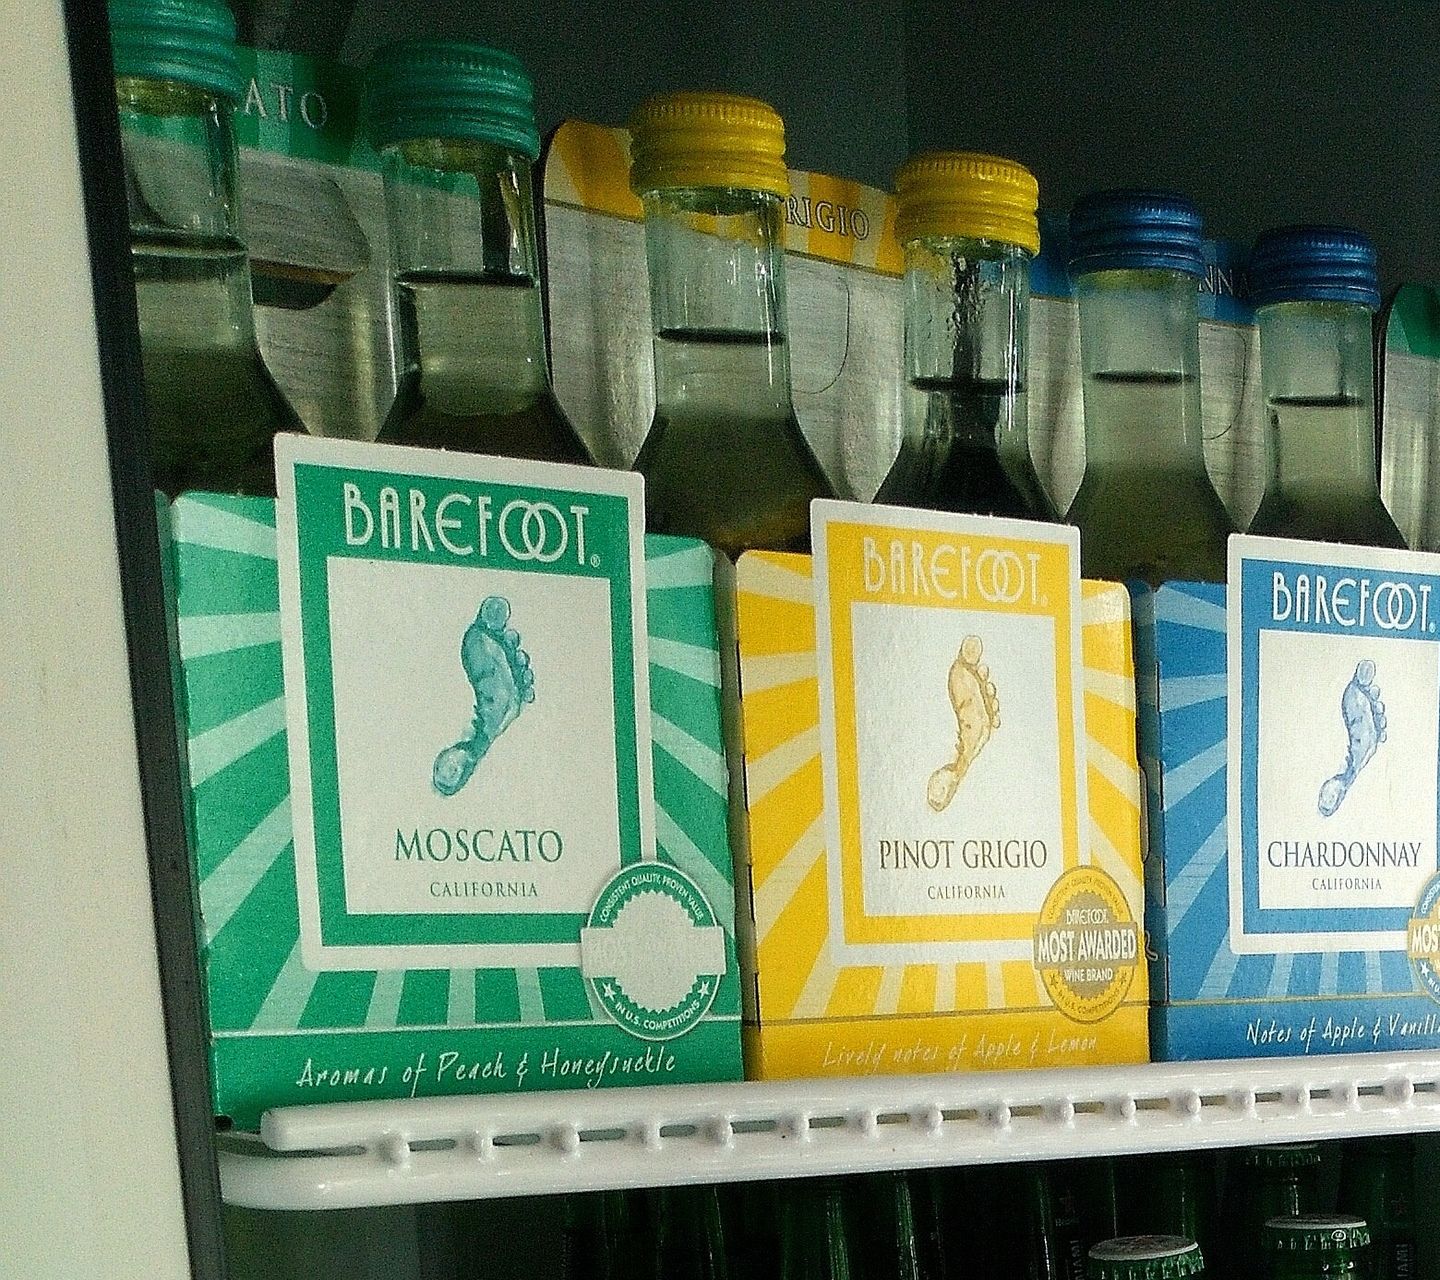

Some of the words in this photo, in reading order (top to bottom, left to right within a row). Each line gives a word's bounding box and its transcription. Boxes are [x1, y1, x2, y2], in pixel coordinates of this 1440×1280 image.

[342, 482, 590, 564] BAREFOOT
[864, 537, 1042, 603] BAREFOOT
[1272, 571, 1431, 632] BAREFOOT
[393, 828, 565, 865] MOSCATO
[878, 840, 955, 869] PINOT
[962, 839, 1049, 869] GRIGIO
[1267, 841, 1421, 869] CHARDONNAY
[429, 880, 539, 899] CALIFORNIA
[927, 884, 1006, 901] CALIFORNIA
[1312, 877, 1382, 891] CALIFORNIA
[1038, 930, 1075, 963] MOST
[1078, 929, 1137, 962] AWARDED
[1064, 968, 1085, 982] WINE
[1087, 967, 1113, 982] BRAND
[643, 999, 701, 1031] COMPETITIONS
[951, 1033, 968, 1067] of
[976, 1031, 1022, 1067] Apple
[1247, 1020, 1292, 1045] Notes
[1301, 1018, 1317, 1053] of
[1324, 1016, 1364, 1051] Apple
[296, 1053, 388, 1088] Aromas
[402, 1045, 428, 1087] of
[438, 1048, 507, 1083] Peach
[541, 1045, 677, 1088] Honeysuckle
